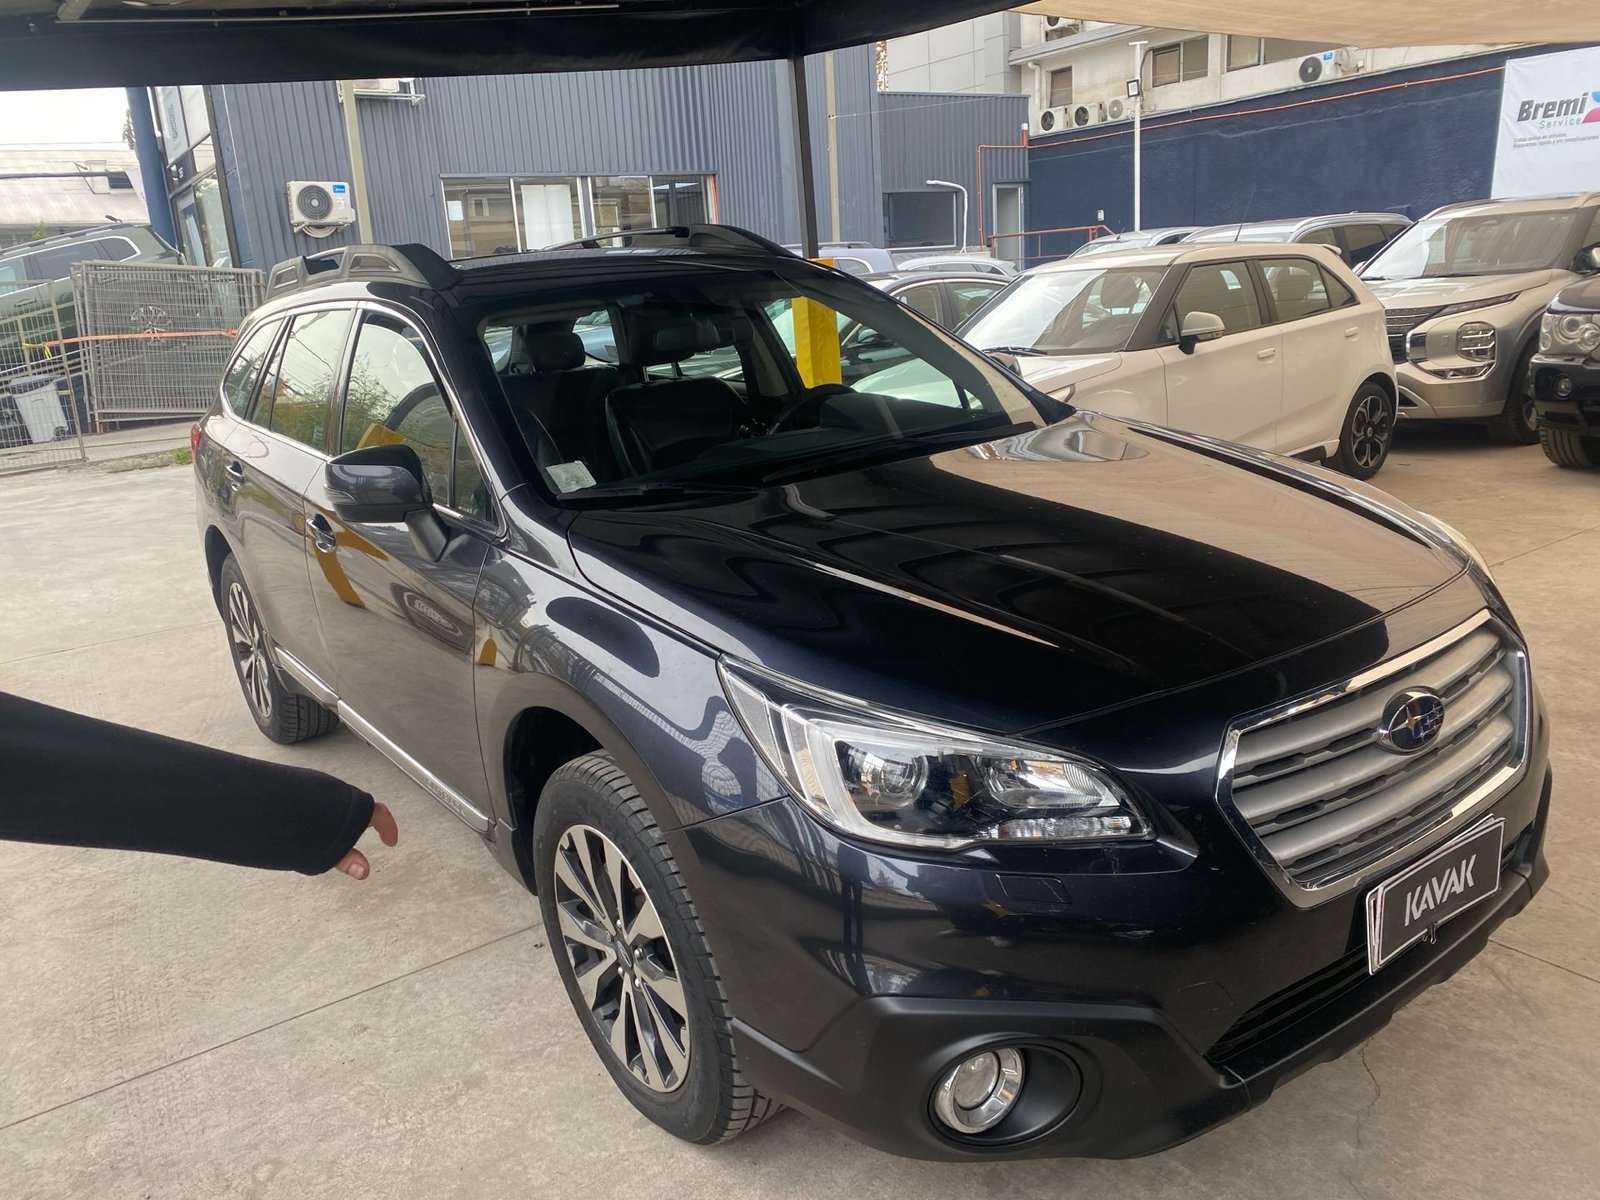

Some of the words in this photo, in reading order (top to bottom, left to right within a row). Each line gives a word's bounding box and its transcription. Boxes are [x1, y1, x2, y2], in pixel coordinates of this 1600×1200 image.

[1517, 92, 1589, 122] Bremi
[1540, 117, 1581, 129] Service
[1404, 854, 1477, 927] KAVAK
